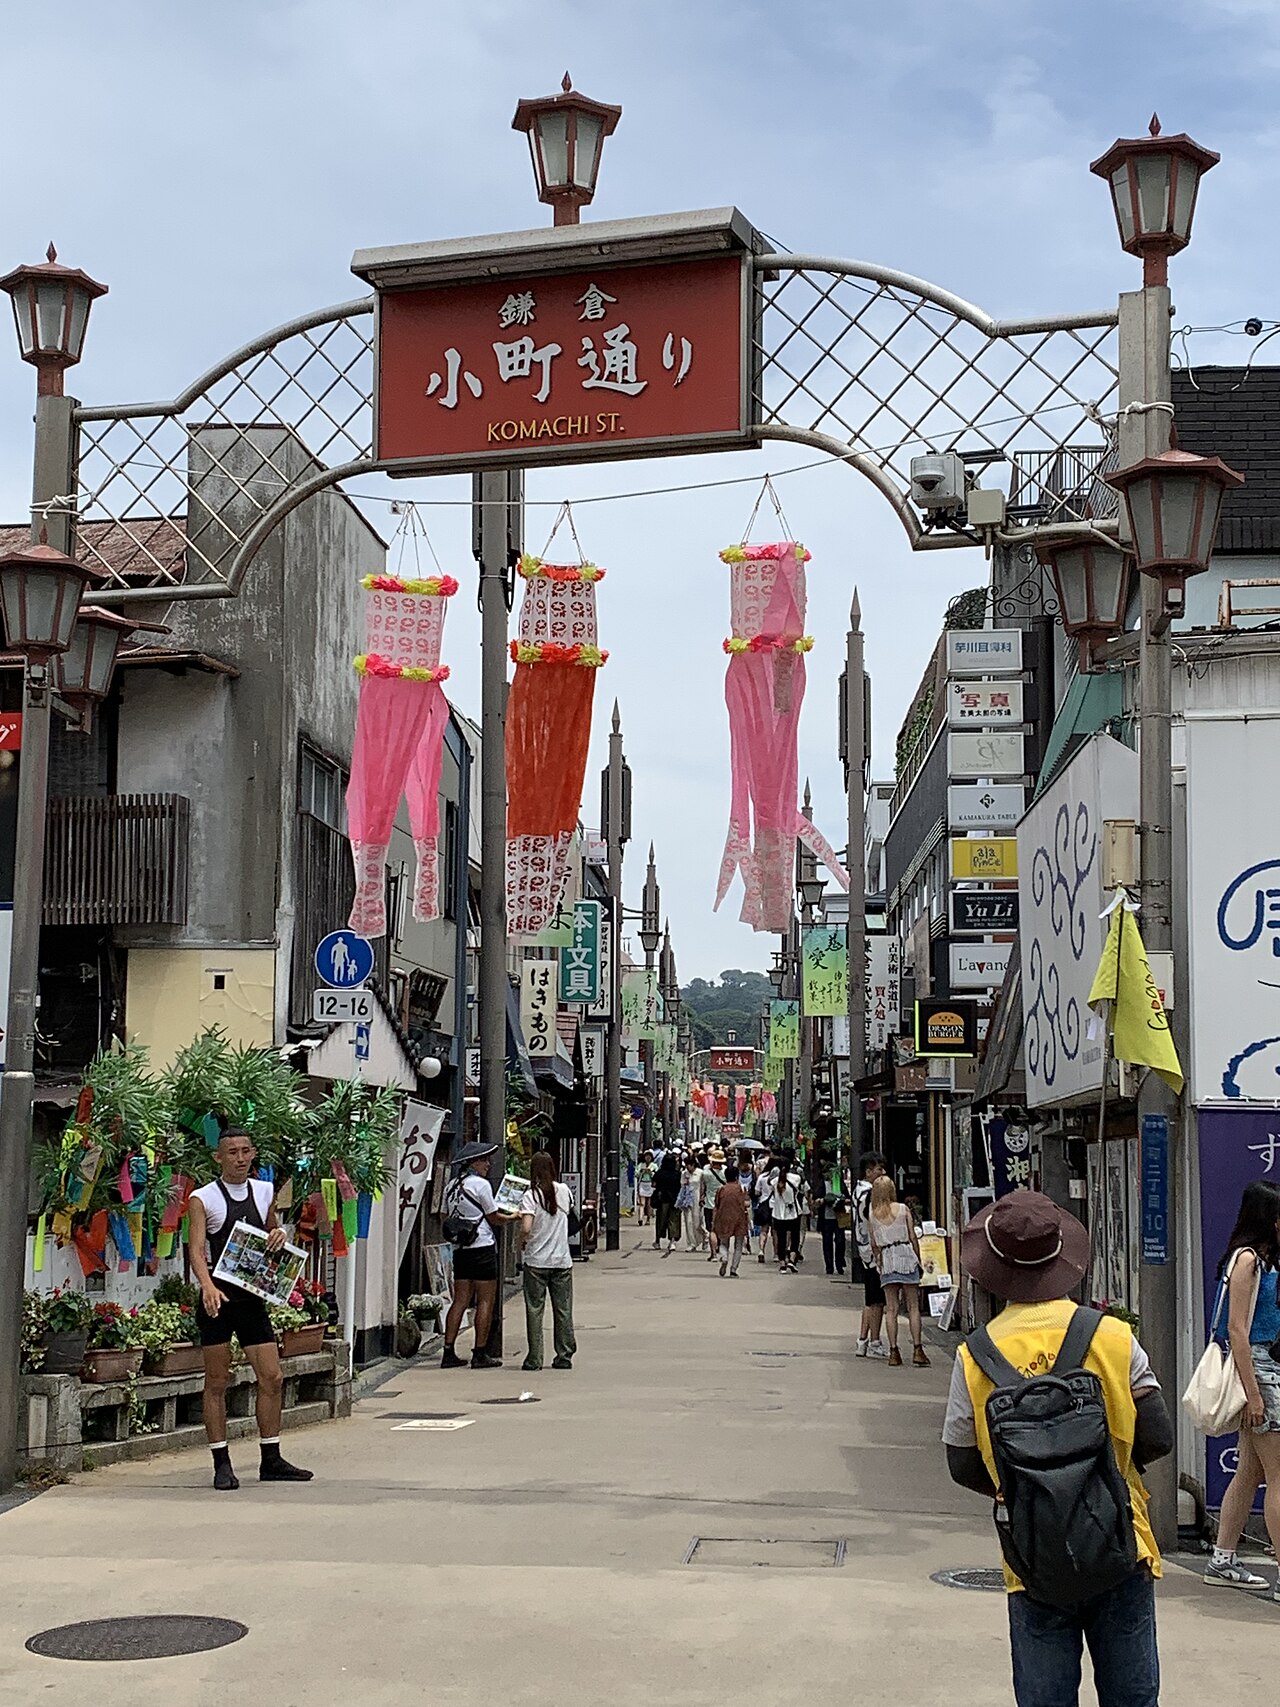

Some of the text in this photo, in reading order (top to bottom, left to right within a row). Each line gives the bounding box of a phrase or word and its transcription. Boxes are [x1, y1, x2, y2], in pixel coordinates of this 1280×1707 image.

[497, 282, 618, 328] 鎌倉
[424, 322, 694, 409] 小町通り
[487, 413, 626, 441] KOMACHI ST.
[958, 813, 996, 821] KAMAKURA
[965, 903, 1013, 917] Yu Li
[318, 996, 369, 1016] 12-16
[528, 967, 550, 1051] はきもの
